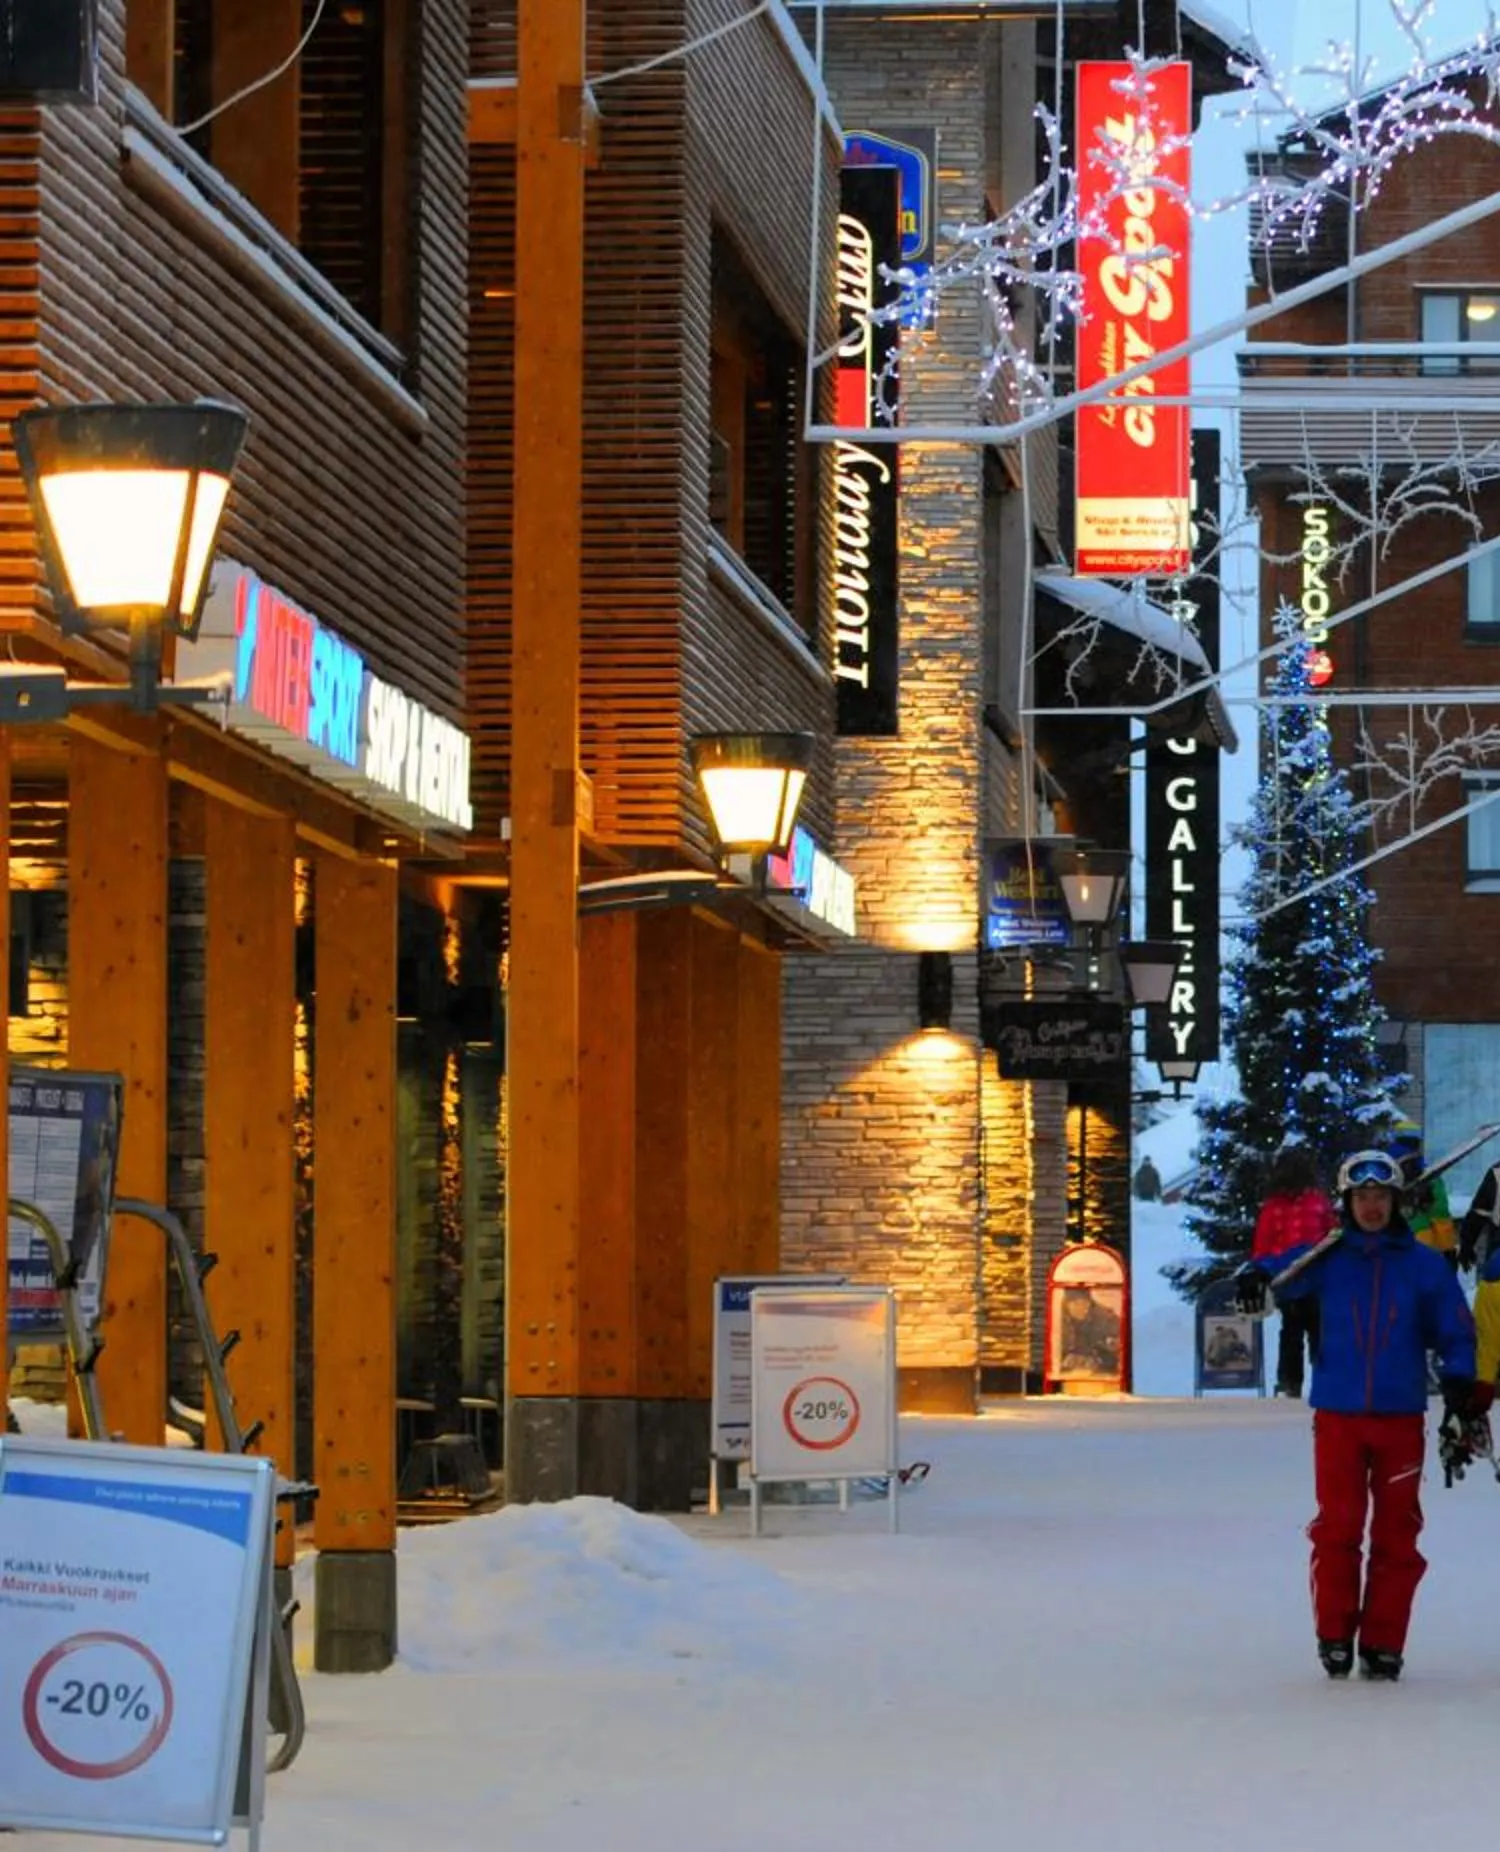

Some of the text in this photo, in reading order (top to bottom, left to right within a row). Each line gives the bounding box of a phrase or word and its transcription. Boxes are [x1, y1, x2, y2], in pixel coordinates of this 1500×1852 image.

[1302, 508, 1329, 643] SOKOS
[235, 575, 363, 769] INTERSPORT
[794, 1401, 849, 1420] -20%
[3, 1558, 151, 1585] Kaikki Vuokraukset
[1, 1575, 139, 1605] Marraskuun ajan
[46, 1679, 151, 1722] -20%
